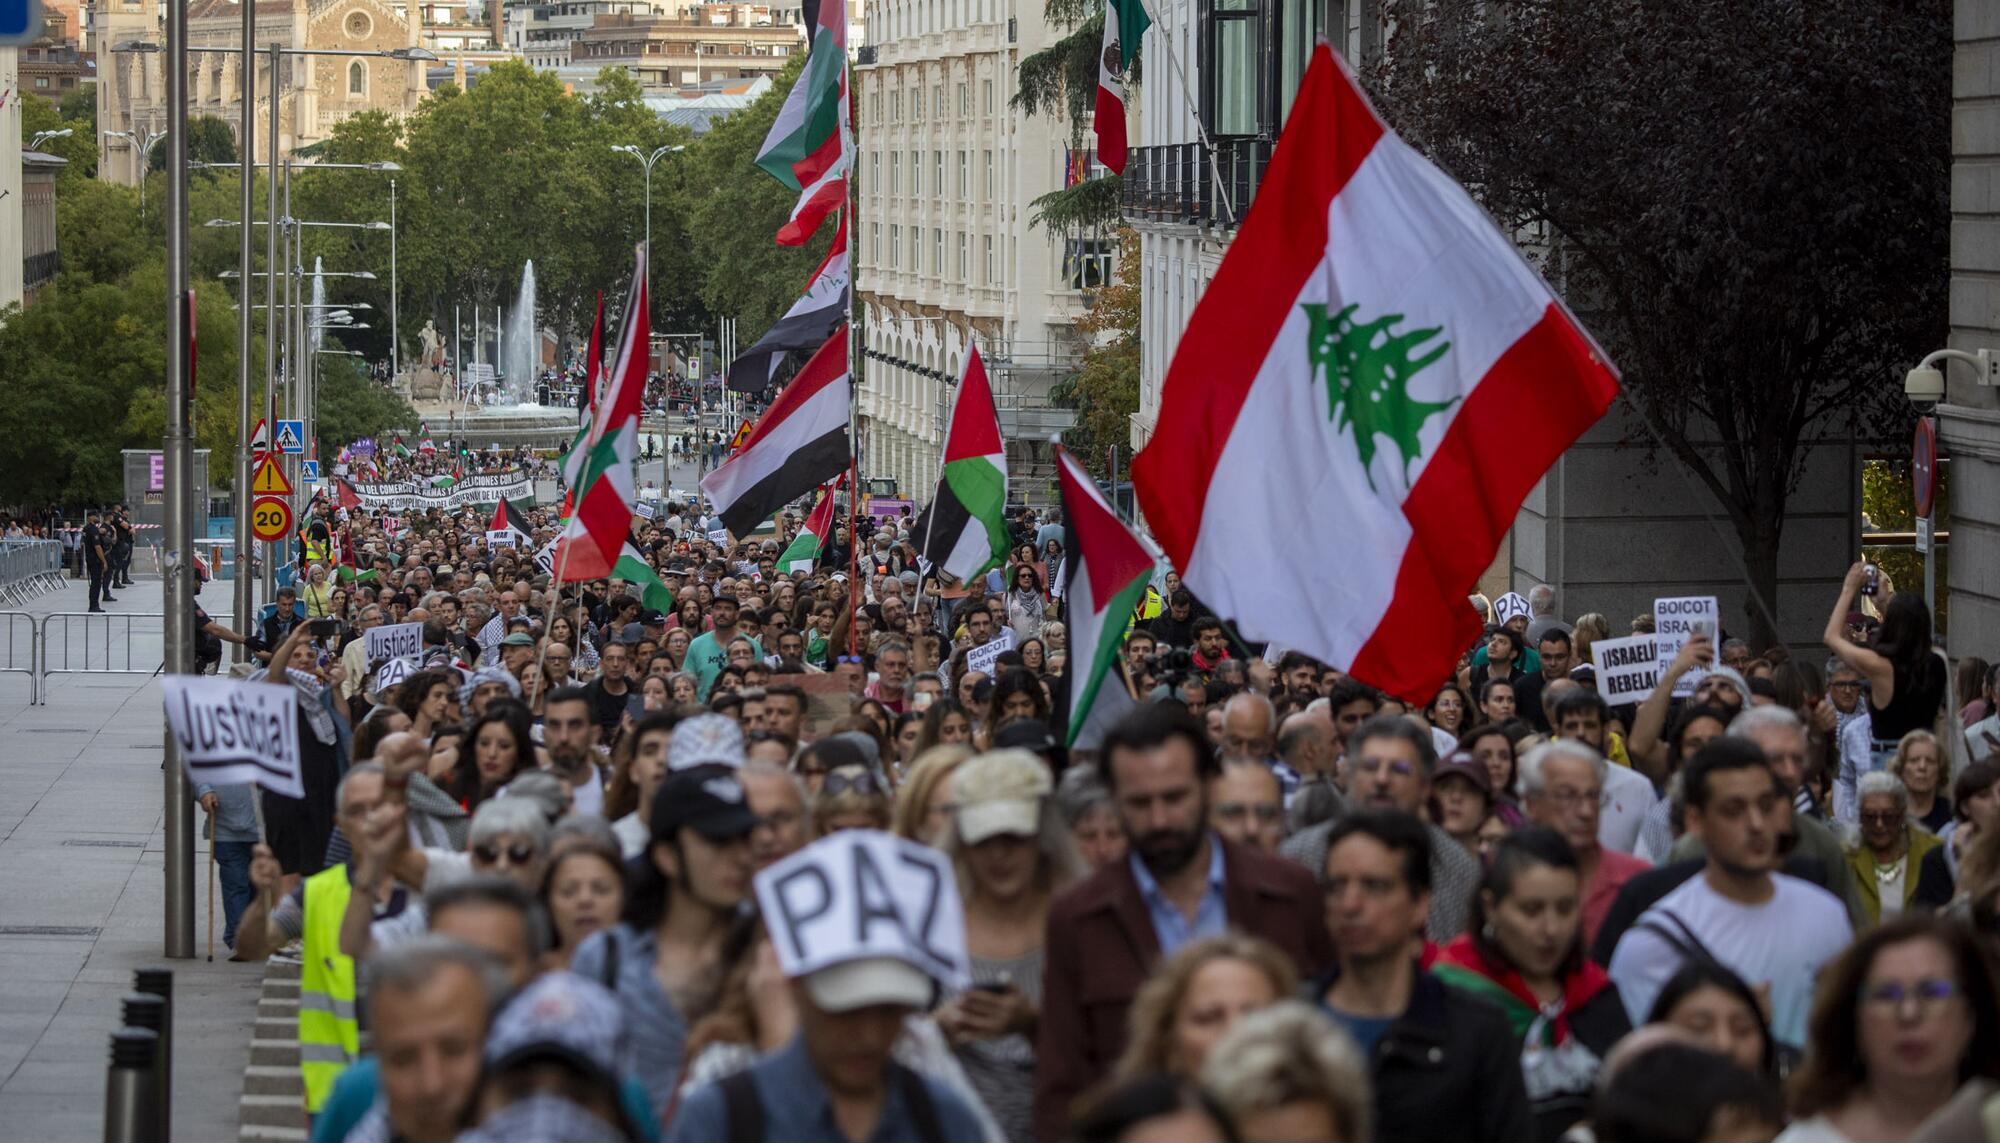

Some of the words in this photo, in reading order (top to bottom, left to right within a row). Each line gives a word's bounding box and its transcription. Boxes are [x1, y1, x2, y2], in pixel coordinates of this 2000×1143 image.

[366, 484, 379, 495] DEL
[379, 483, 413, 495] COMERCIO
[499, 474, 513, 486] CON
[365, 497, 385, 508] BASTA
[482, 491, 490, 500] DE
[256, 511, 283, 526] 20
[493, 531, 508, 539] WAR
[1496, 593, 1533, 624] PAZ
[1658, 600, 1711, 614] BOICOT
[1658, 620, 1691, 634] ISRA
[367, 627, 420, 659] Justicia!
[969, 639, 1007, 660] BOICOT
[970, 655, 997, 672] ISRAE
[1602, 640, 1657, 671] ¡ISRAELÍ
[178, 687, 293, 762] Justicia!
[773, 843, 957, 971] PAZ
